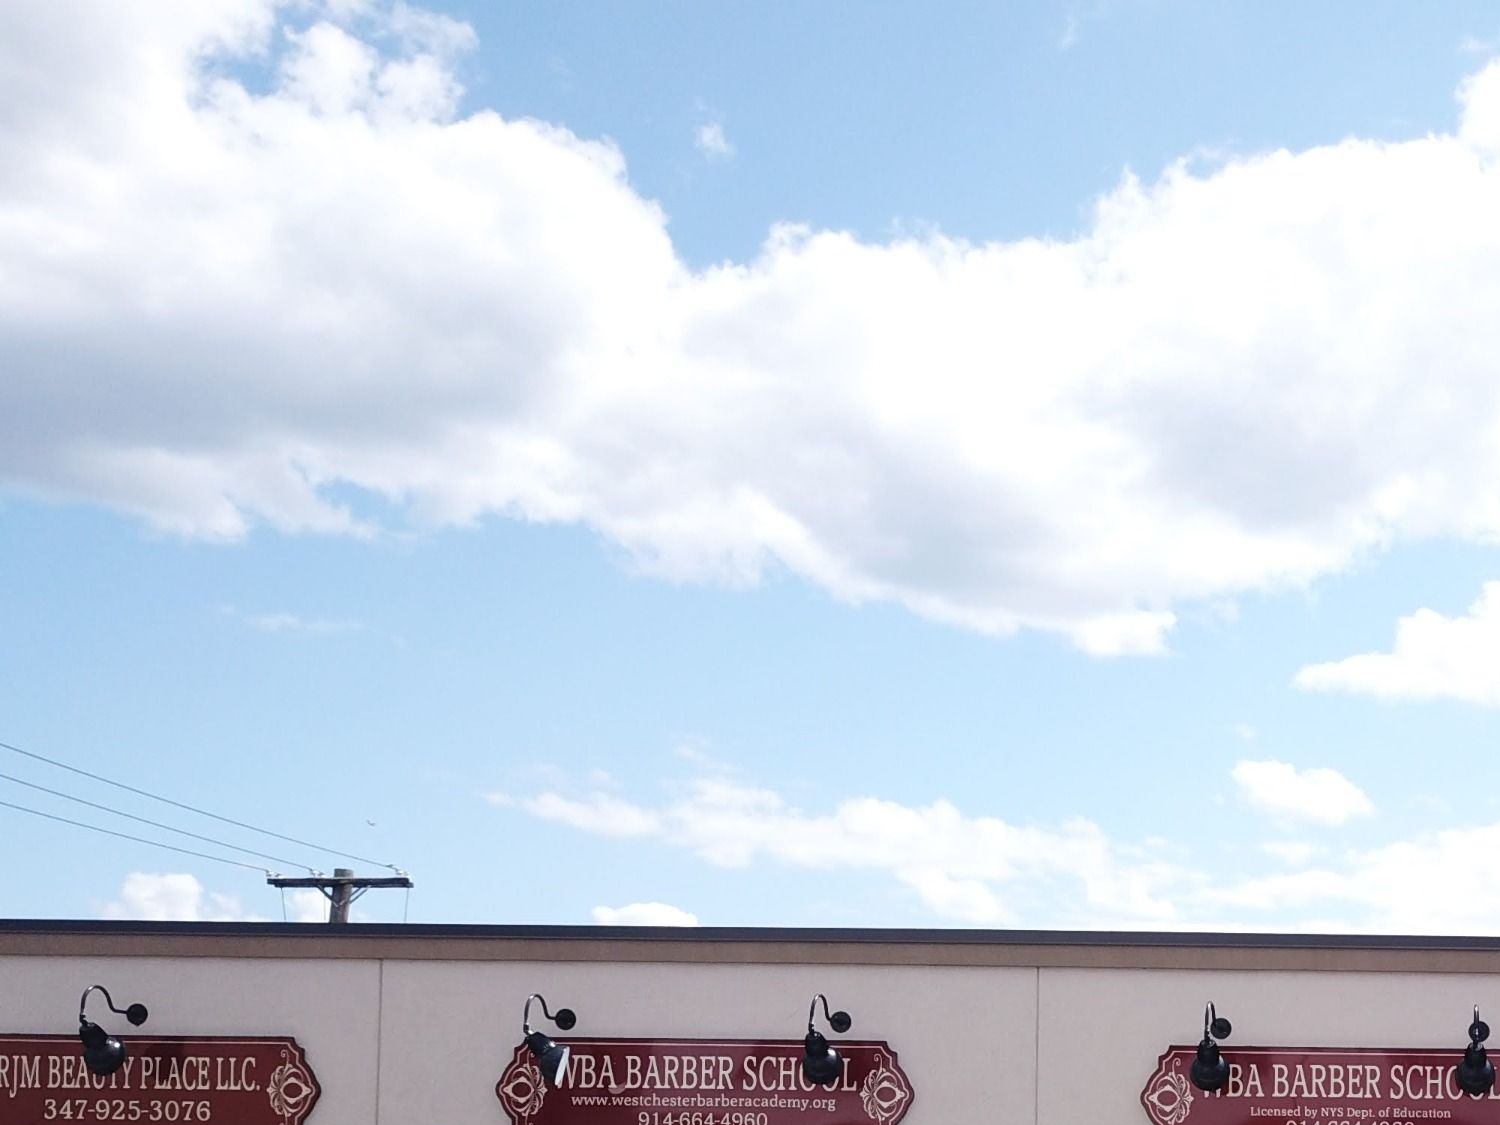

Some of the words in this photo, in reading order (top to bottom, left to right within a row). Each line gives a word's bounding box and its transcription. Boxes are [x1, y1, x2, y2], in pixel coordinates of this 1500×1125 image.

[140, 1056, 211, 1090] PLACE
[216, 1057, 260, 1091] LLC.
[625, 1055, 734, 1091] BARBER
[1204, 1063, 1265, 1098] BA
[1272, 1063, 1381, 1099] BARBER
[44, 1099, 211, 1121] 347-925-3076
[571, 1094, 836, 1111] www.westchesterbarberacademy.org
[1250, 1106, 1301, 1117] Licensed
[1304, 1106, 1318, 1118] by
[1320, 1107, 1344, 1117] NYS
[1346, 1107, 1375, 1120] Dept.
[1378, 1106, 1391, 1118] of
[1393, 1107, 1451, 1119] Education
